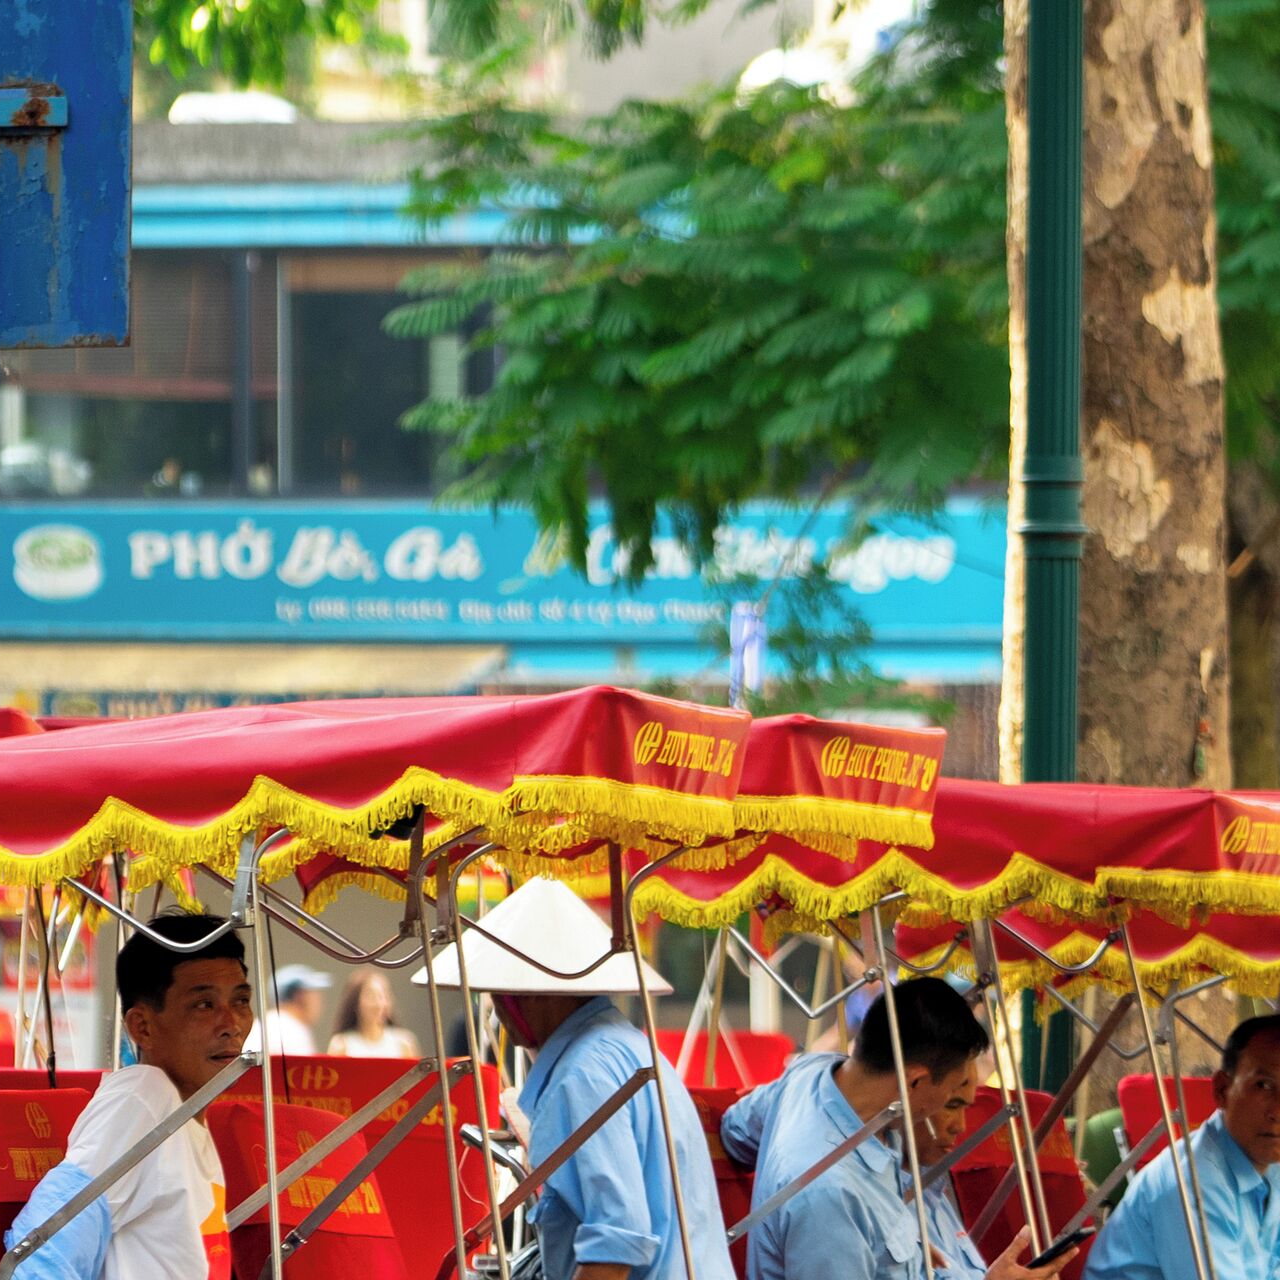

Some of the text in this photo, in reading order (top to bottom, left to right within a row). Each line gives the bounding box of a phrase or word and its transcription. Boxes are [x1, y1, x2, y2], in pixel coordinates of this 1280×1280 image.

[129, 517, 273, 581] PHỞ
[656, 730, 688, 766] HUY
[845, 744, 876, 778] HUY
